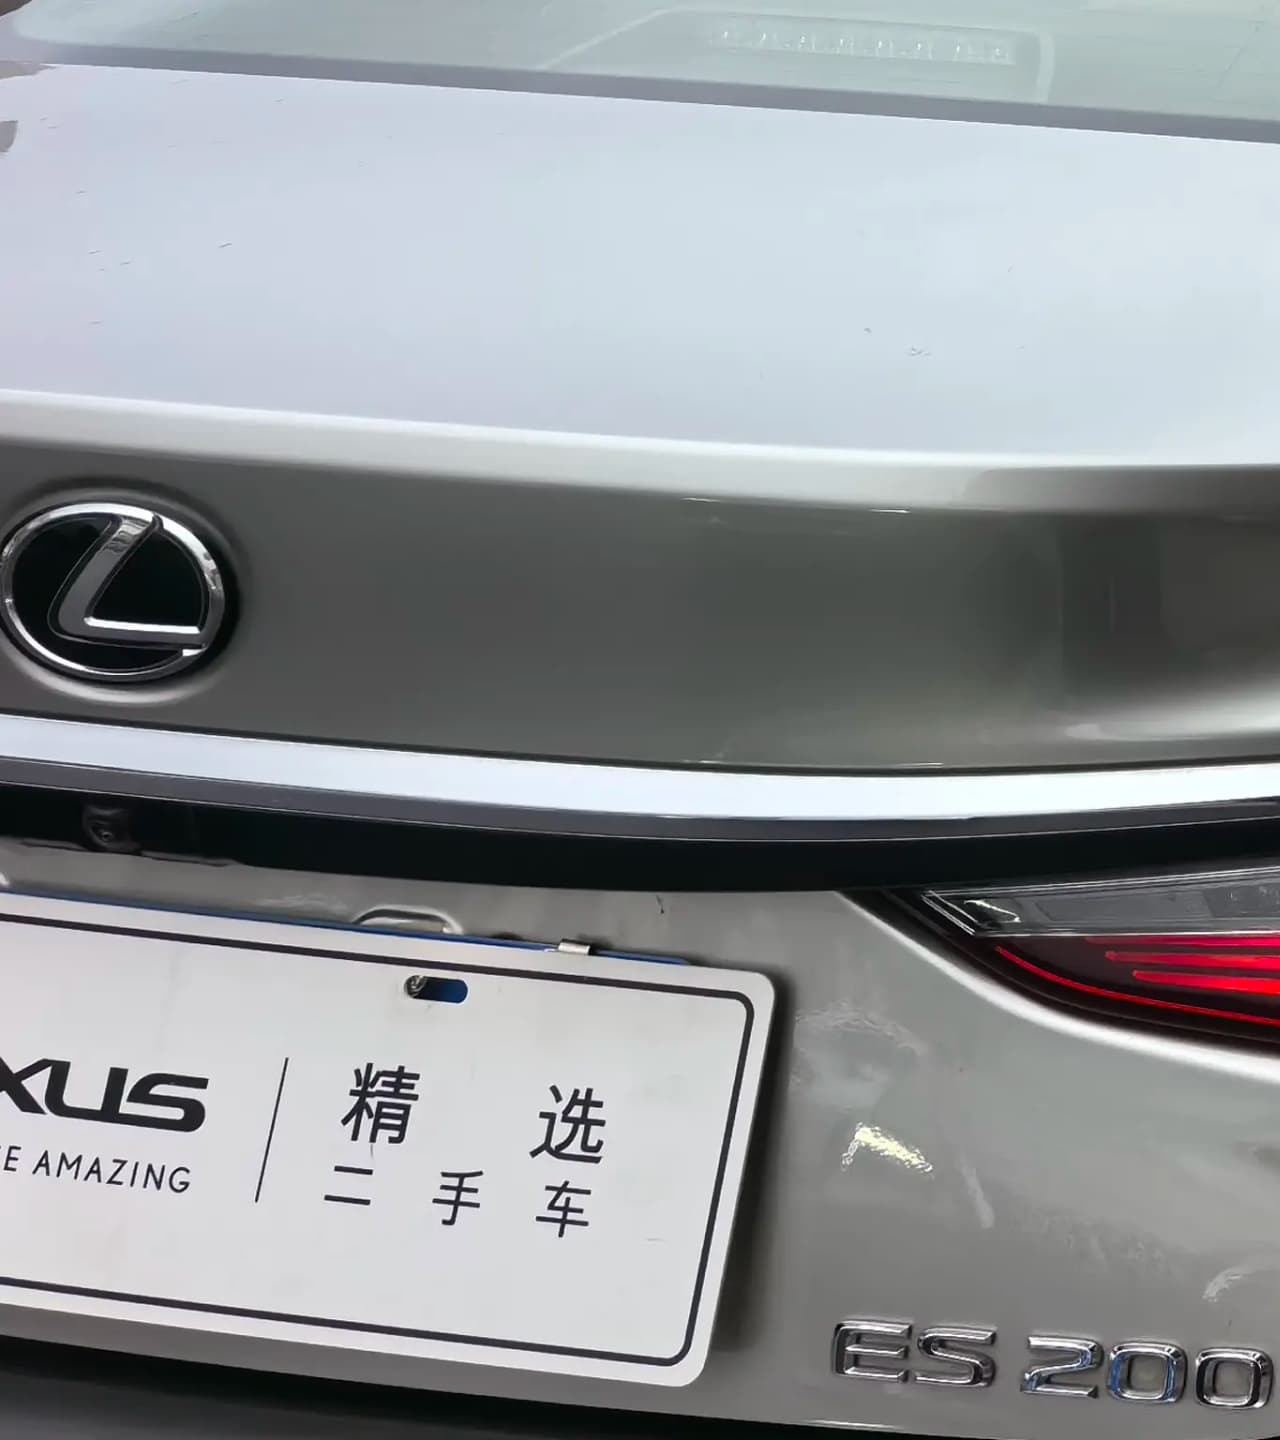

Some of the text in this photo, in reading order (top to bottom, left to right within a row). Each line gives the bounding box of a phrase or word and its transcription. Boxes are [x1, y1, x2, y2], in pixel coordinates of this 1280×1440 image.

[341, 1062, 606, 1164] 精选
[31, 1149, 192, 1194] AMAZING
[323, 1165, 591, 1238] 二手车
[831, 1319, 1275, 1410] ES 200
